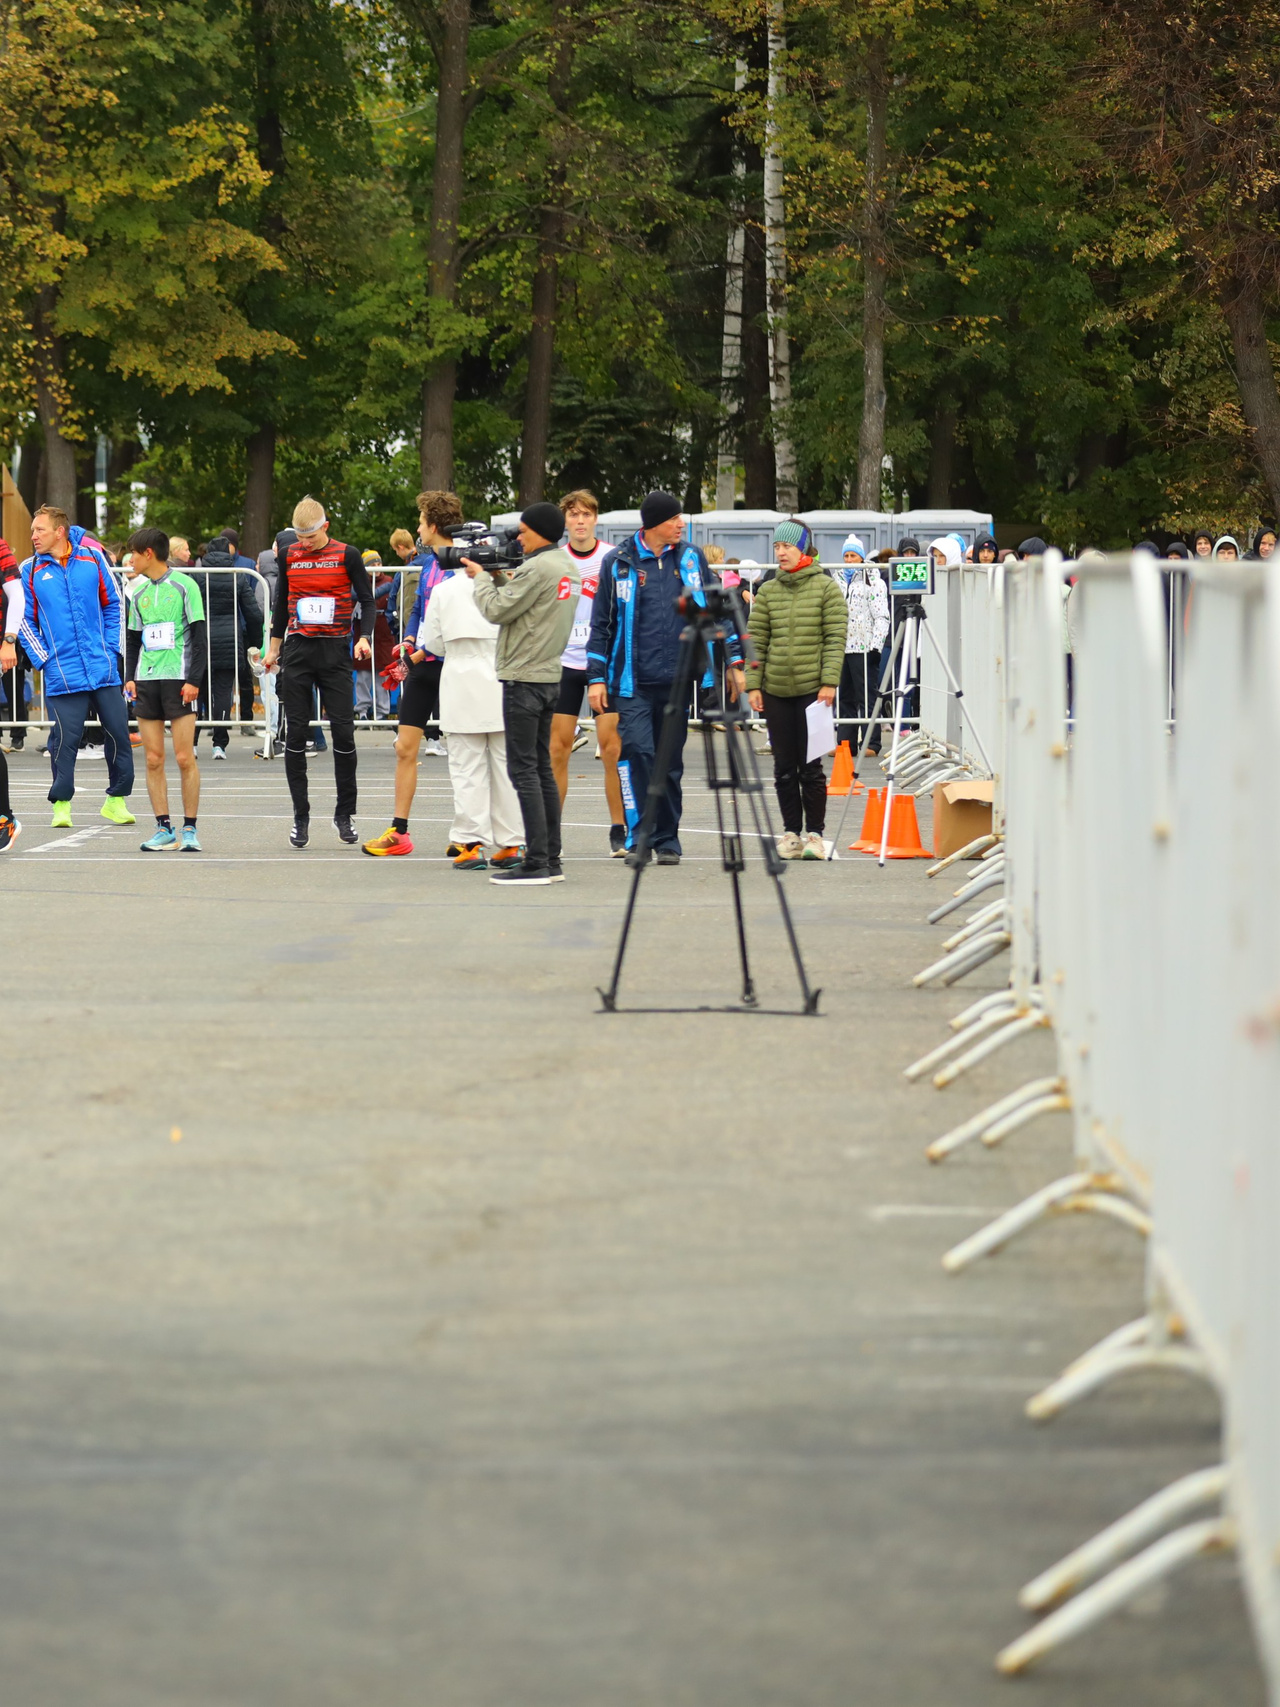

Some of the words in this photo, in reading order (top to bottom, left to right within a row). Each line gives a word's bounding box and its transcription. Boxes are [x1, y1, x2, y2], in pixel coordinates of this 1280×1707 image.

[291, 561, 313, 569] NORD
[315, 561, 339, 569] WEST
[308, 604, 322, 614] 3.1
[150, 629, 162, 640] 4.1
[574, 627, 588, 637] 1.1
[617, 766, 636, 810] RUSSIA
